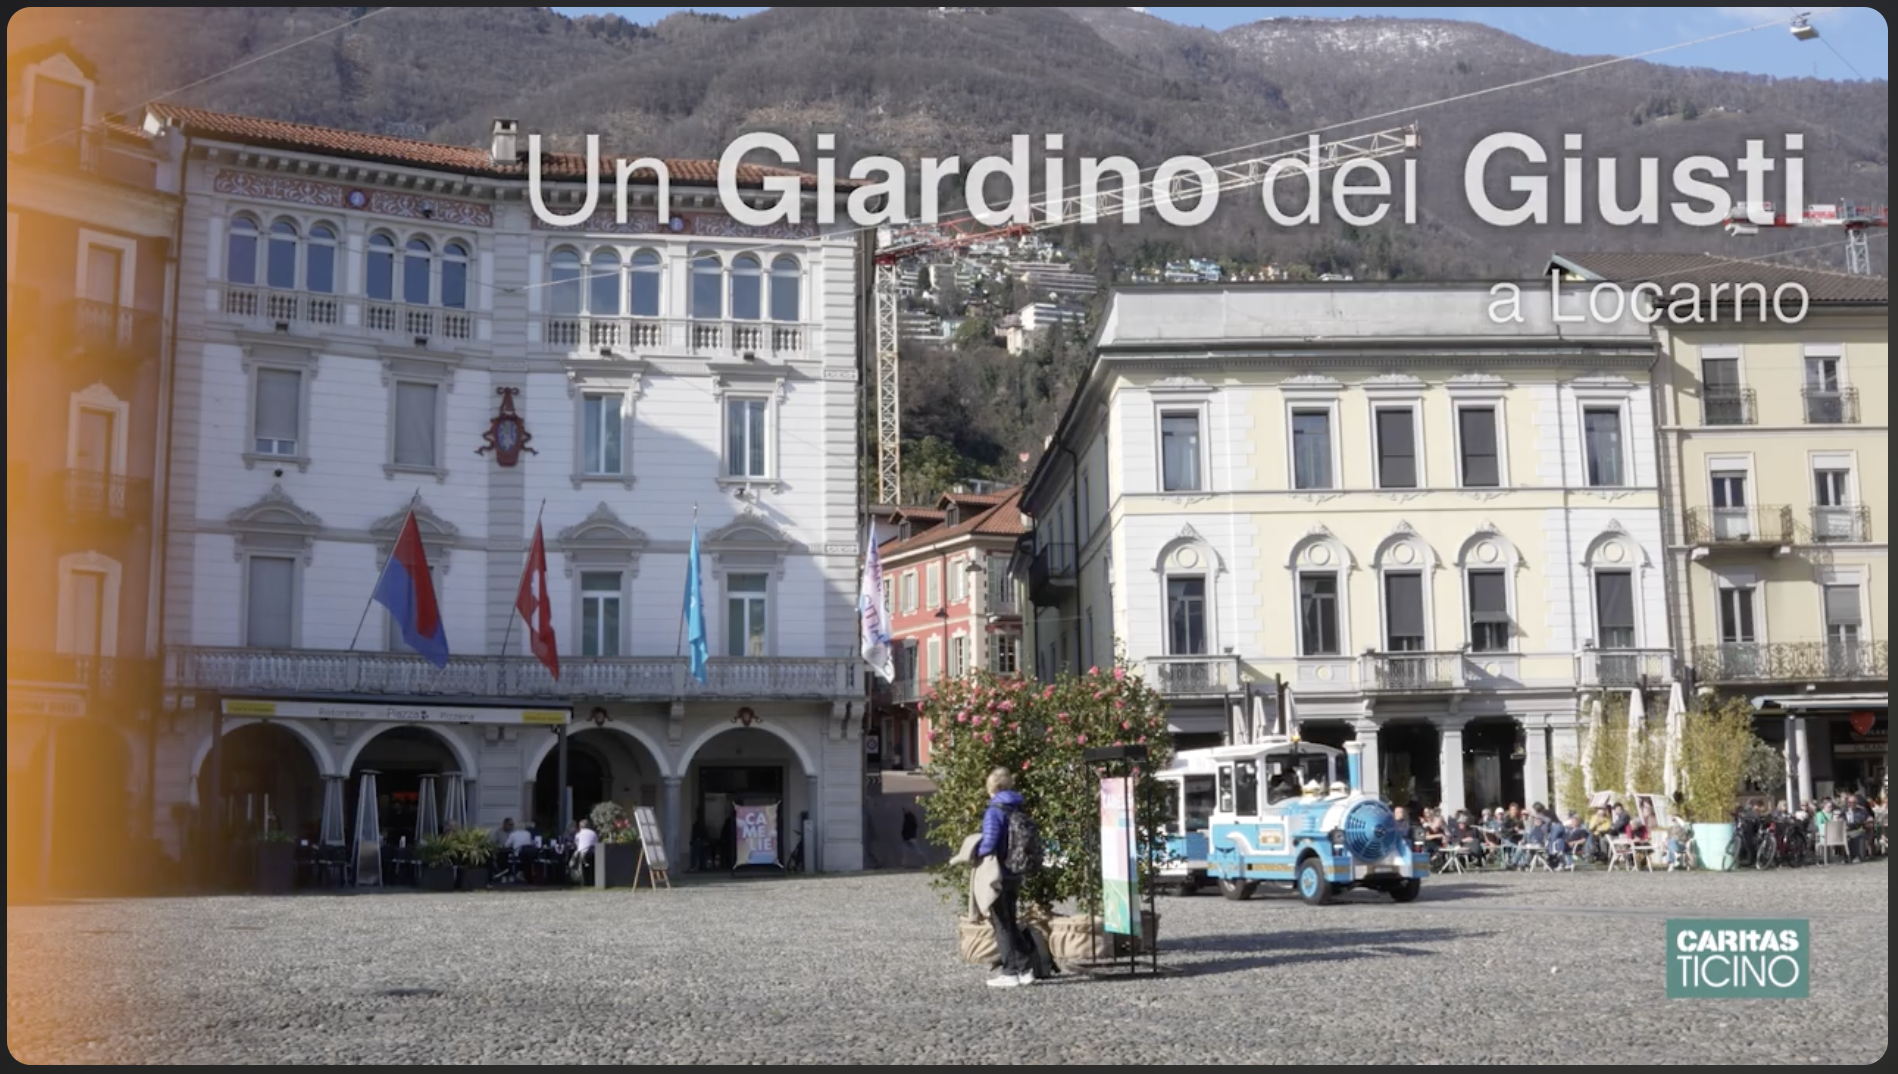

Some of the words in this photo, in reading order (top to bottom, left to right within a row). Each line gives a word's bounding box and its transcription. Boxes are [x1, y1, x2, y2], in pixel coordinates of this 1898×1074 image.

[387, 707, 420, 719] Piazza
[745, 812, 767, 826] CA
[742, 825, 766, 838] ME
[750, 838, 772, 851] LIE
